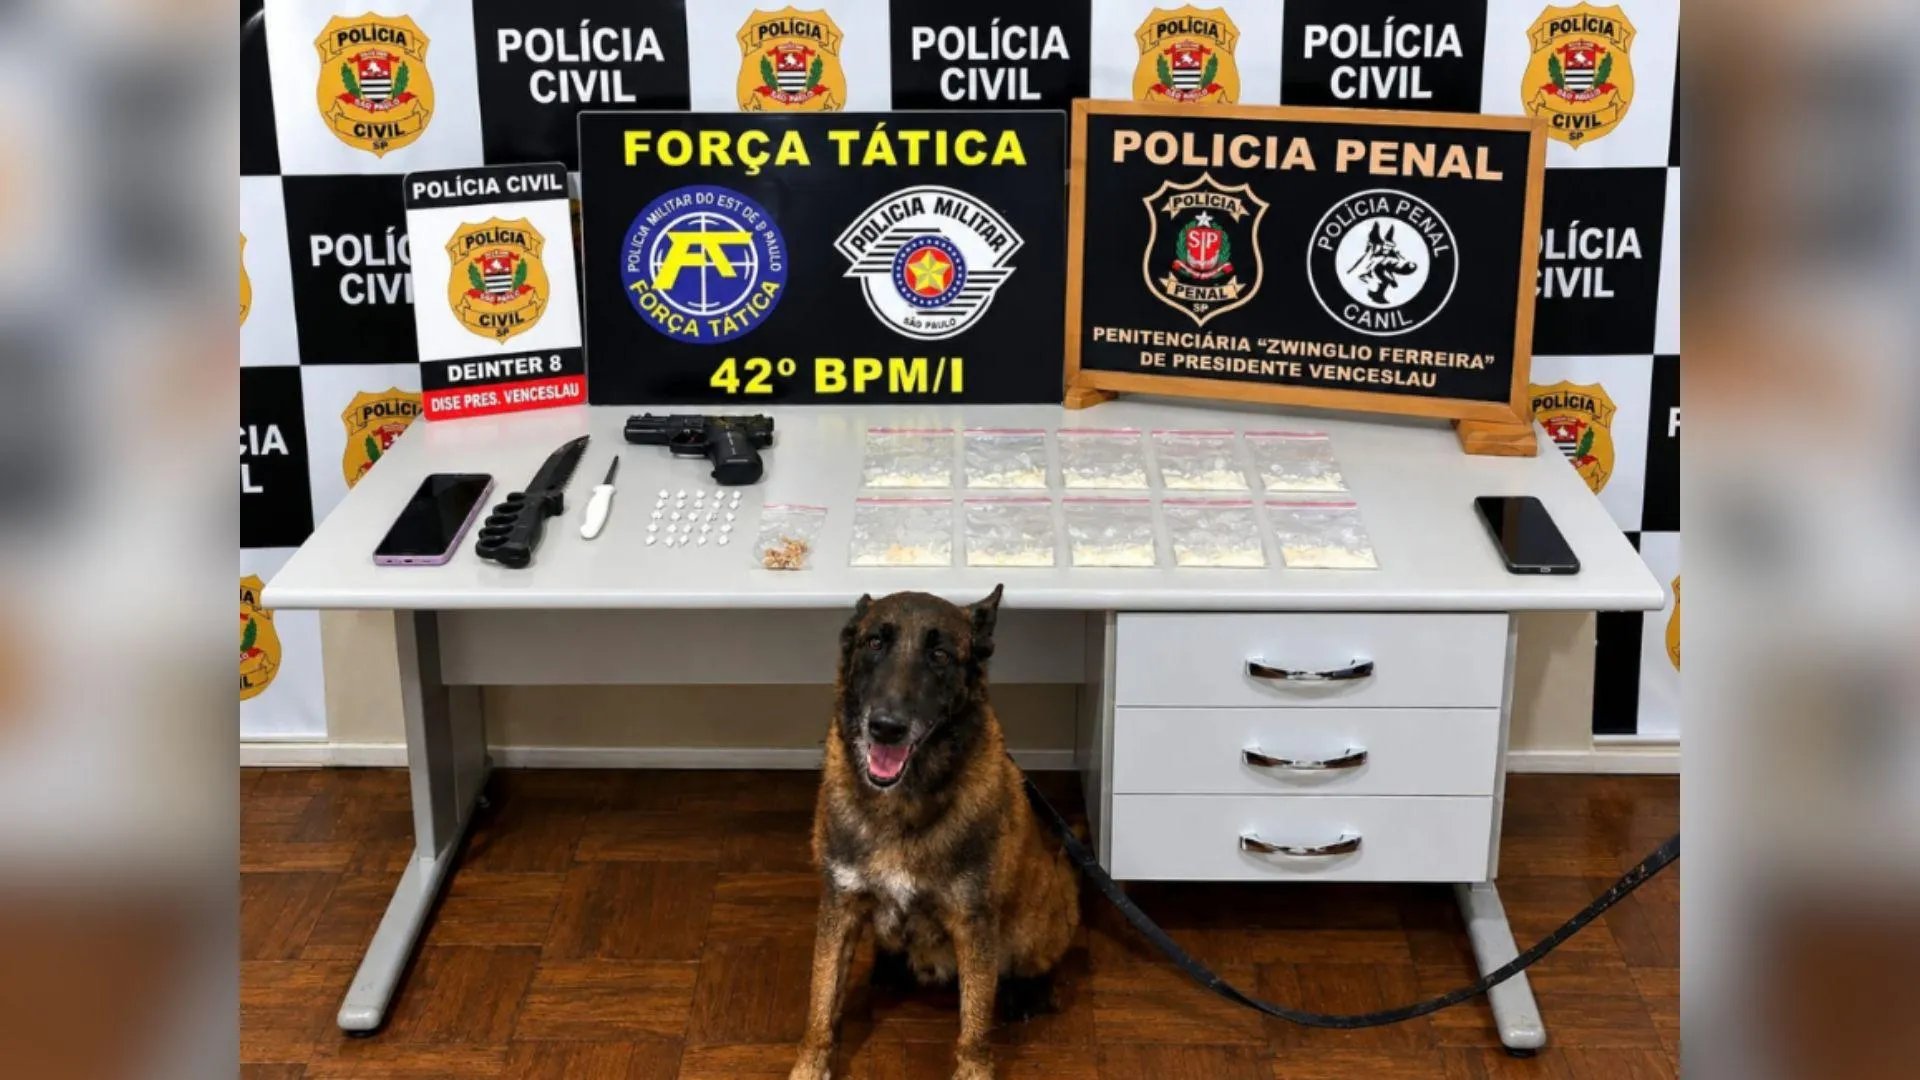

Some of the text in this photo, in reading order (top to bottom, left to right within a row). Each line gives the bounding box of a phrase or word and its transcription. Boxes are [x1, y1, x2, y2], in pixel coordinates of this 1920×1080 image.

[337, 23, 407, 47] POLÍCIA
[498, 19, 664, 62] POLÍCIA
[758, 18, 822, 40] POLÍCIA
[911, 18, 1070, 61] POLÍCIA
[1157, 15, 1218, 38] POLÍCIA
[1304, 16, 1463, 59] POLÍCIA
[1549, 13, 1614, 37] POLÍCIA
[529, 70, 636, 103] CIVIL
[940, 67, 1041, 101] CIVIL
[1330, 66, 1432, 99] CIVIL
[353, 122, 405, 138] CIVIL
[1552, 114, 1601, 128] CIVIL
[1569, 132, 1584, 140] SP
[624, 122, 1027, 175] FORÇA TÁTICA
[1112, 129, 1503, 181] POLICIA PENAL
[412, 174, 563, 199] POLÍCIA CIVIL
[646, 194, 692, 226] MILITAR
[695, 192, 714, 204] DO
[717, 195, 743, 212] EST
[763, 231, 782, 272] PAULO
[933, 196, 1008, 253] MILITAR
[1396, 200, 1449, 258] PENAL
[1539, 220, 1642, 259] LÍCIA
[310, 226, 411, 267] POLÍC
[340, 272, 413, 305] CIVI
[1175, 286, 1229, 299] PENAL
[1536, 267, 1614, 298] IVIL
[479, 313, 525, 326] CIVIL
[629, 279, 780, 337] FORÇA TÁTICA
[1344, 304, 1413, 329] CANIL
[1093, 326, 1251, 352] PENITENCIÁRIA
[447, 354, 562, 382] DEINTER 8
[814, 356, 963, 394] BPM/I
[1140, 351, 1437, 388] DE PRESIDENTE VENCESLAU
[431, 383, 580, 412] DISE PRES. VENCESLAU
